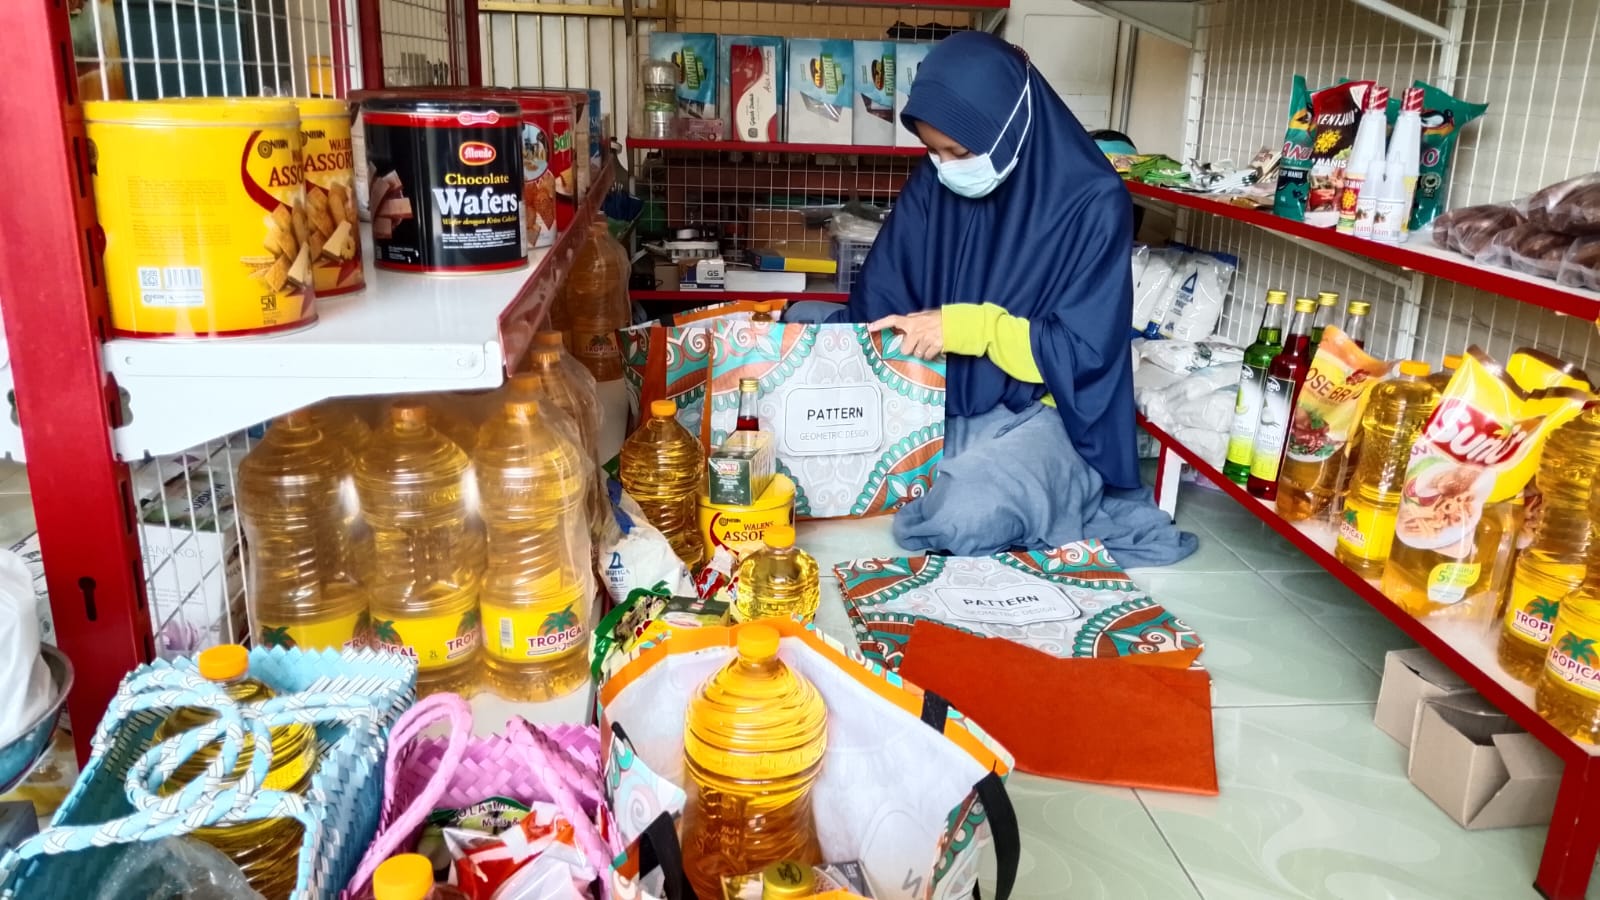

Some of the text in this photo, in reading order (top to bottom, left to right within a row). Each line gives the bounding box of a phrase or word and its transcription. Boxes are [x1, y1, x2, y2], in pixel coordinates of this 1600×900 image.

[445, 173, 509, 185] Chocolate
[432, 187, 518, 215] Wafers
[807, 407, 863, 420] PATTERN
[963, 595, 1040, 607] PATTERN
[1516, 610, 1553, 634] TROPI
